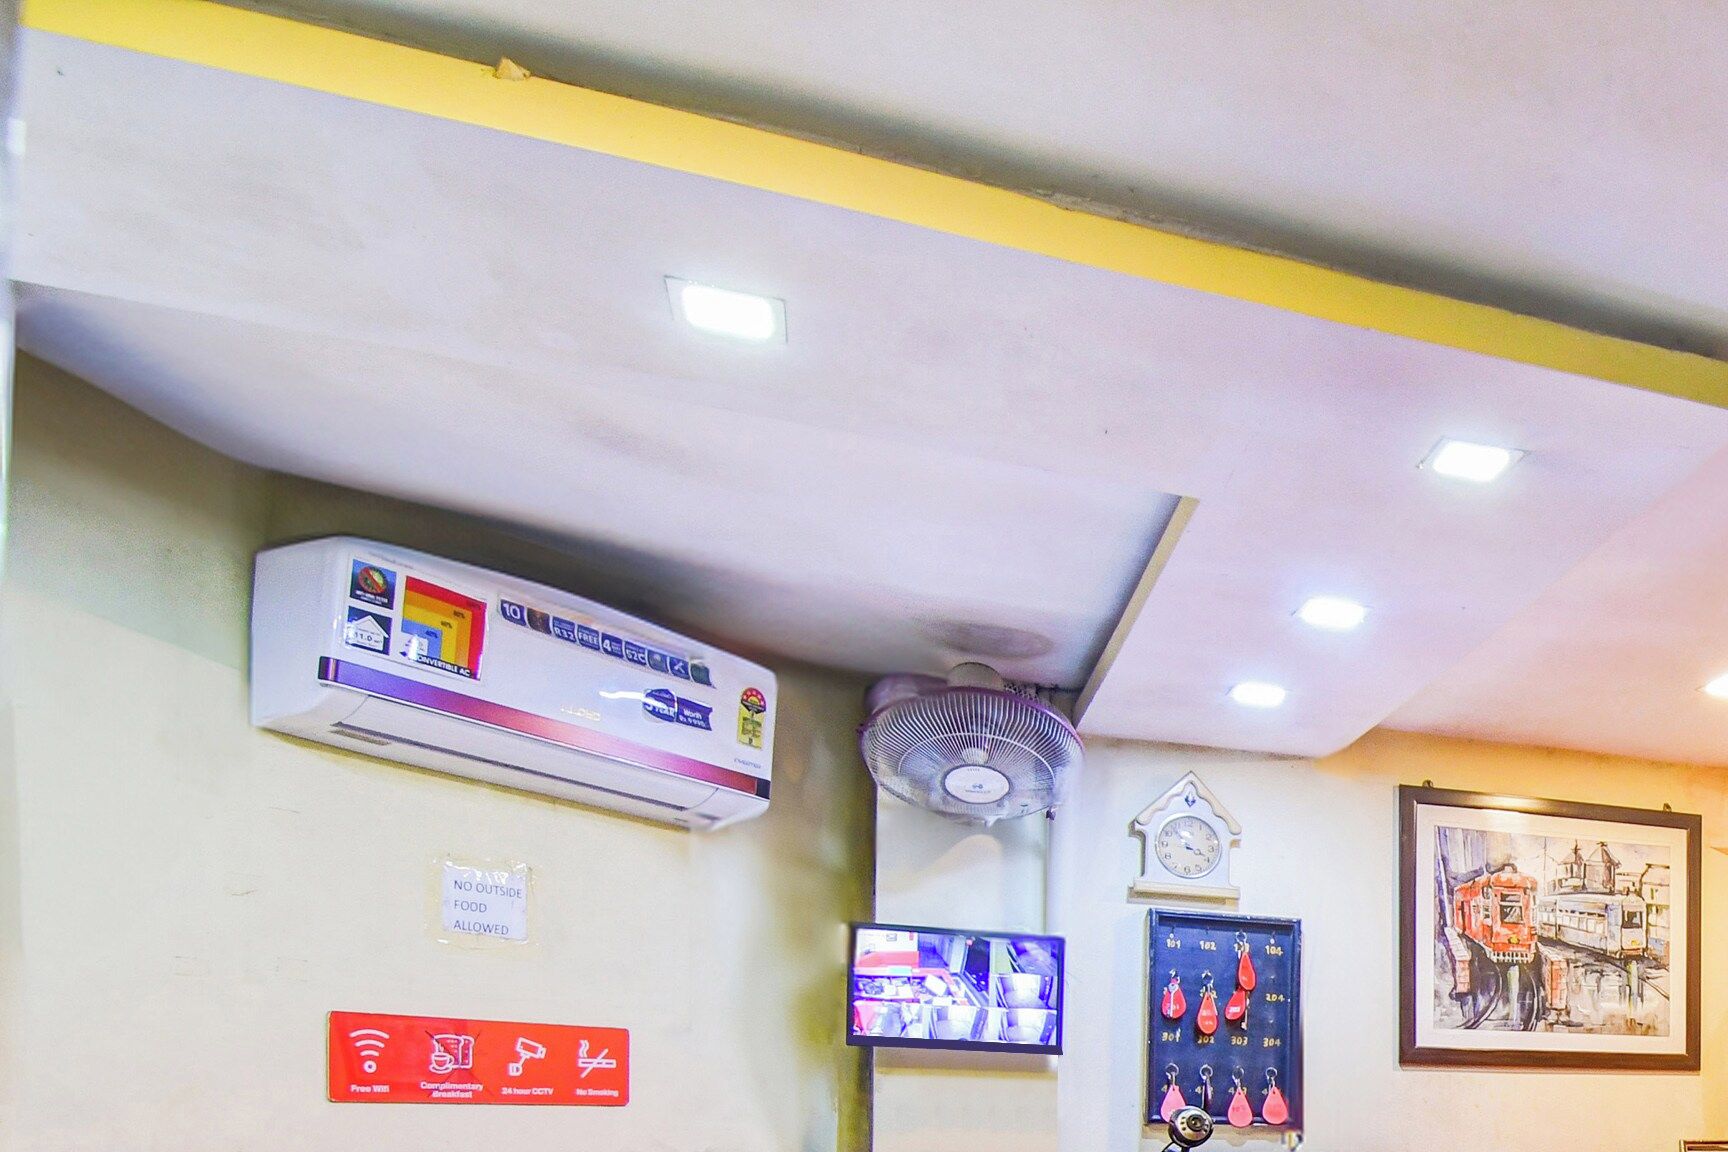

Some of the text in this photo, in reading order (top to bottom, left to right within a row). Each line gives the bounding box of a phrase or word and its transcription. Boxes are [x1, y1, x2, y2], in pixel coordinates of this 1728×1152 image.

[503, 604, 521, 619] 10
[554, 627, 575, 641] R32
[578, 632, 598, 645] FREE
[603, 639, 611, 652] 4
[416, 655, 458, 674] ONVERTIBLE
[454, 880, 523, 899] NO OUTSIDE
[454, 900, 487, 913] FOOD
[454, 920, 509, 935] ALLOWED
[1166, 939, 1181, 949] 101
[1200, 941, 1216, 950] 102
[1265, 945, 1283, 956] 104
[1231, 1036, 1248, 1046] 303
[1263, 1037, 1281, 1047] 304
[351, 1084, 371, 1093] Free
[420, 1081, 484, 1092] Complimentary
[532, 1087, 554, 1095] CCTV
[575, 1088, 588, 1096] No
